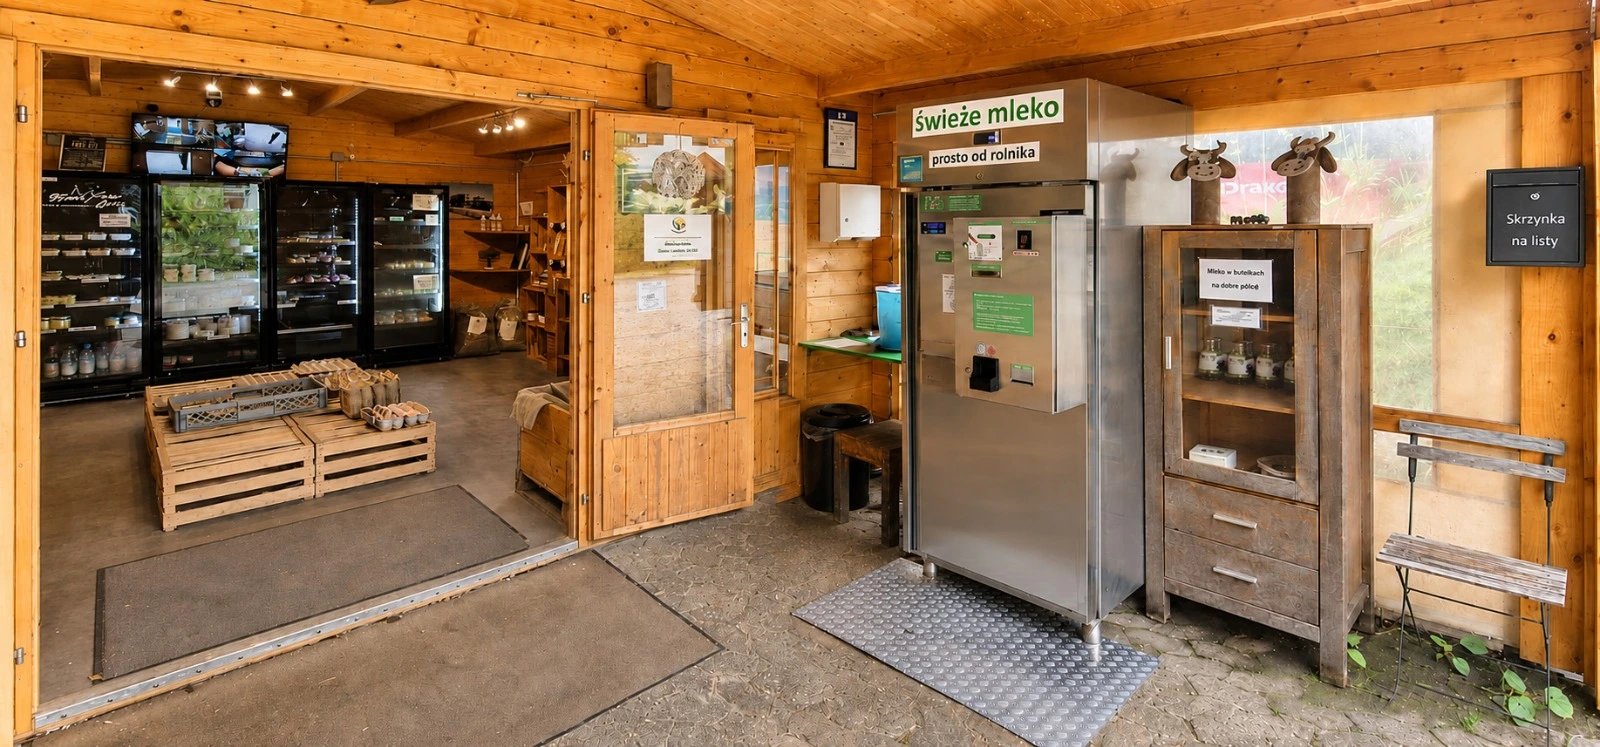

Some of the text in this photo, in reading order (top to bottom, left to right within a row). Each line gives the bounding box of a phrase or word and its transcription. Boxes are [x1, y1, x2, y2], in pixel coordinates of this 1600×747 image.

[915, 96, 1059, 132] świeże mleko
[932, 151, 968, 167] prosto
[971, 149, 987, 162] od
[991, 146, 1035, 161] rolnika
[1507, 213, 1565, 226] Skrzynka
[1512, 235, 1558, 248] na listy
